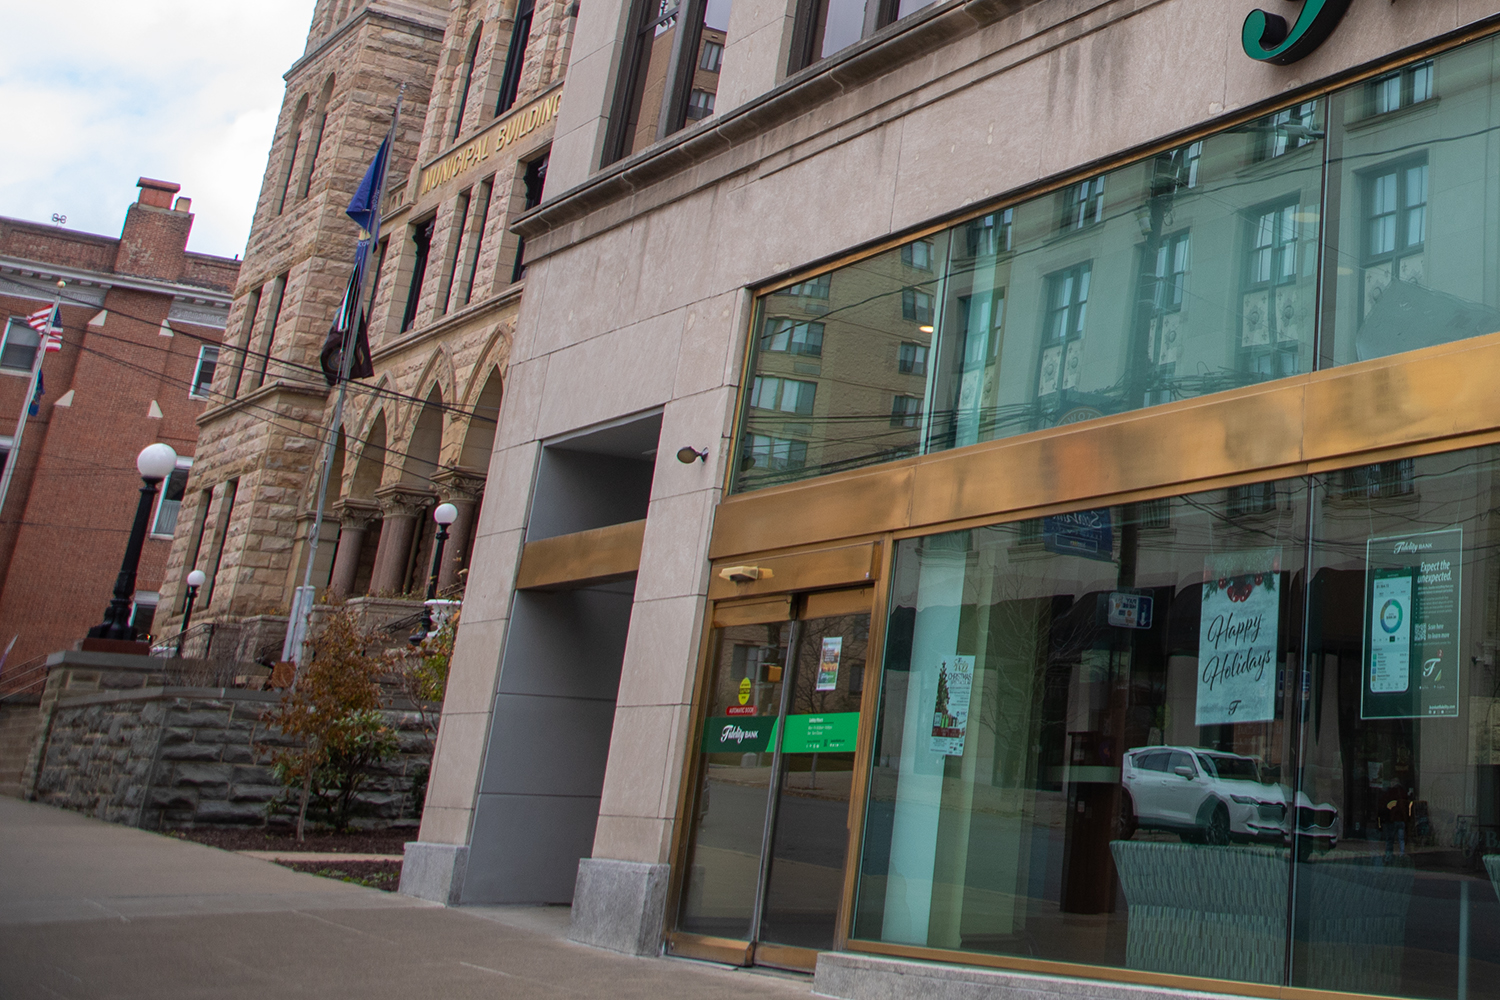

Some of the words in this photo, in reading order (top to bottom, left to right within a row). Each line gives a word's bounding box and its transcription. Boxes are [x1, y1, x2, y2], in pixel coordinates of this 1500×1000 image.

[422, 135, 489, 195] MUNICIPAL
[496, 90, 564, 152] BUILDING
[1393, 541, 1418, 554] Fidelity
[1420, 561, 1440, 574] Expect
[1440, 559, 1451, 570] the
[1417, 570, 1452, 585] unexpected.
[1207, 612, 1263, 650] Happy
[1202, 647, 1273, 691] Holidays
[720, 724, 745, 744] Fidelity
[744, 730, 759, 739] BANK
